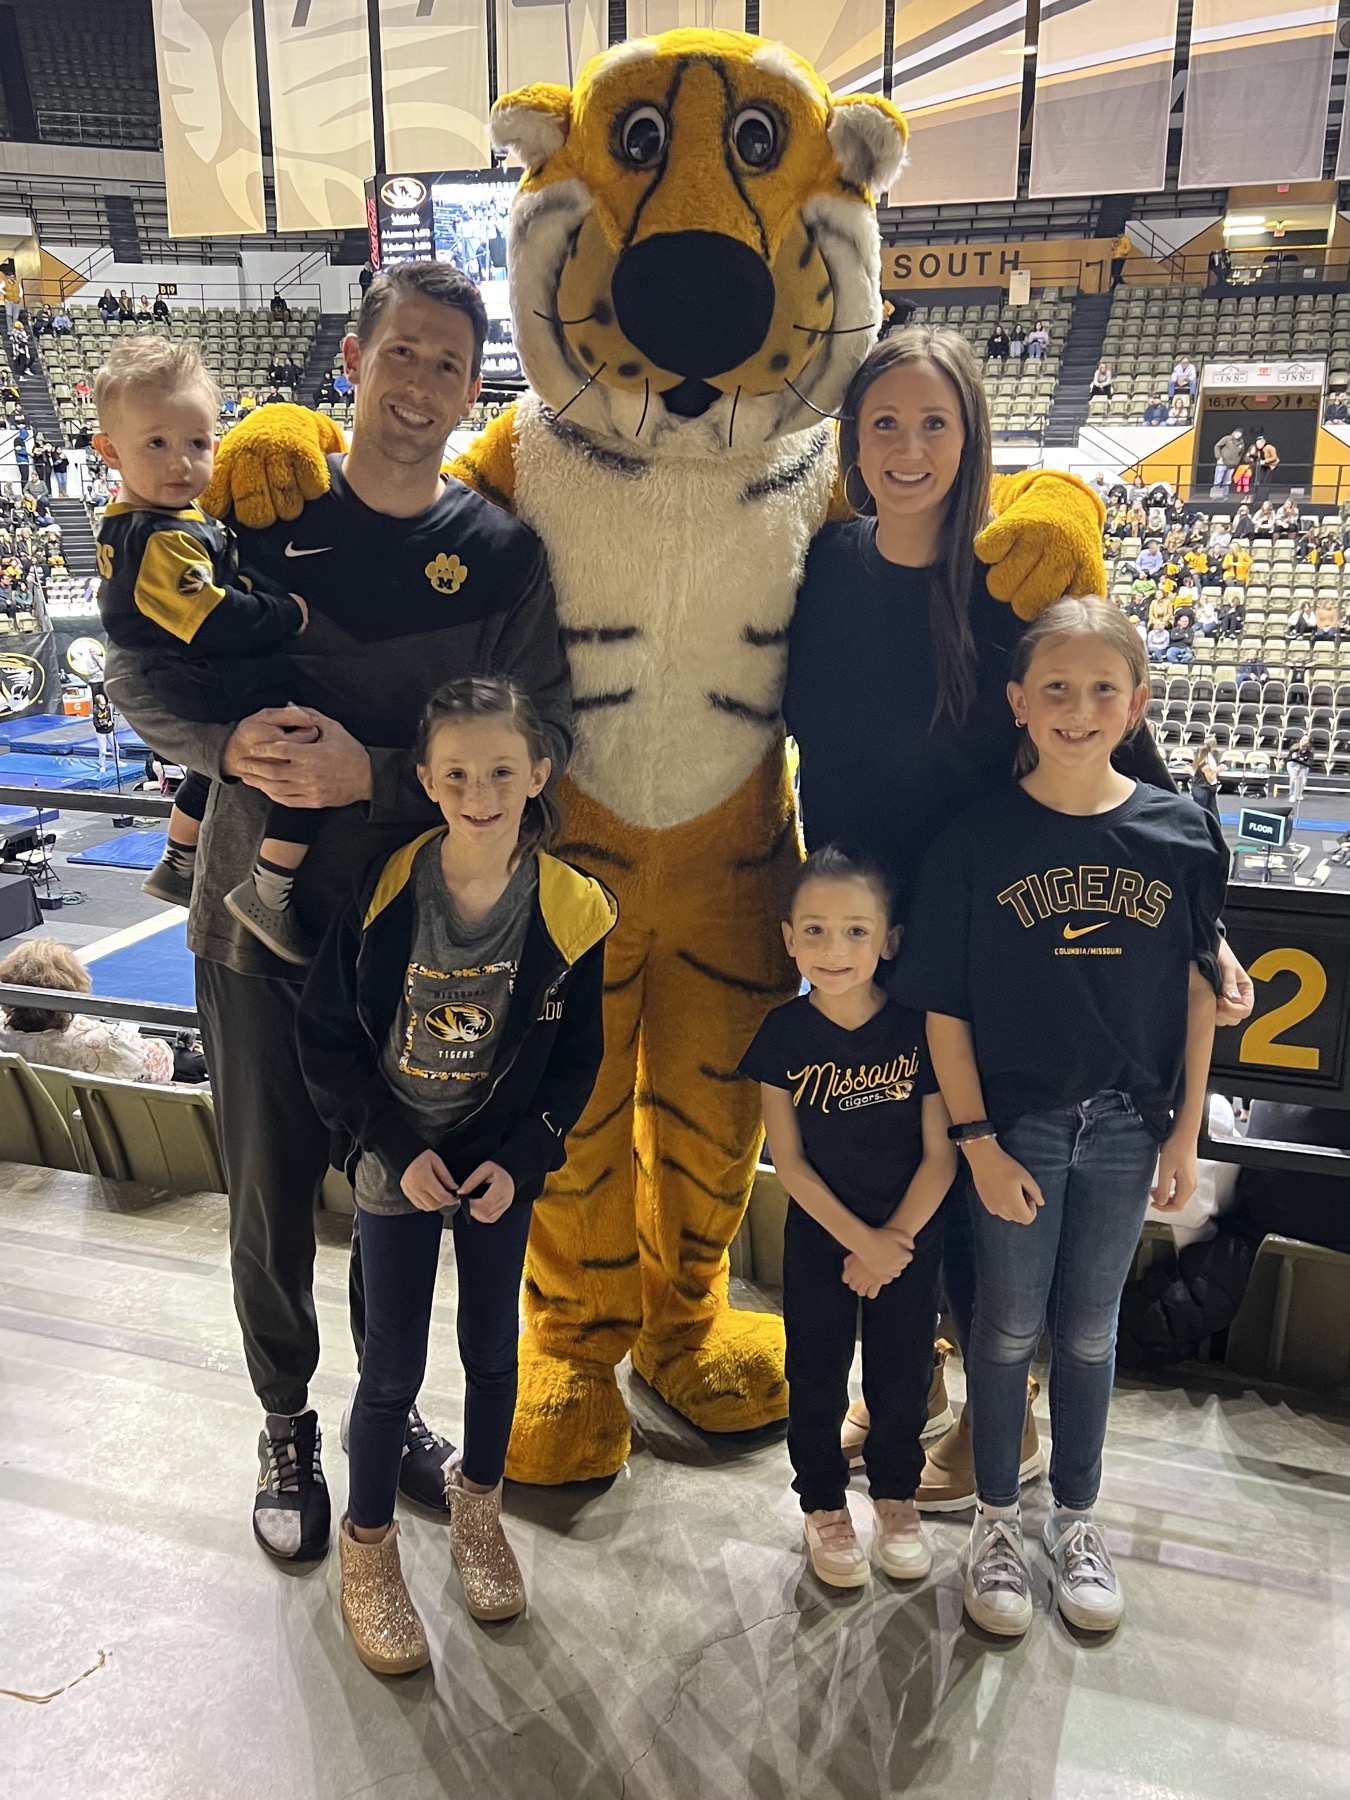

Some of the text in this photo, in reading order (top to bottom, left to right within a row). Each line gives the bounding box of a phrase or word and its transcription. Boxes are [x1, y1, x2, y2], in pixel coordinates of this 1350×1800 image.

[893, 250, 1020, 279] SOUTH
[73, 703, 82, 711] G
[1248, 821, 1274, 835] FLOOR
[997, 866, 1173, 928] TIGERS
[1239, 947, 1327, 1071] 2
[438, 1050, 475, 1059] TIGERS
[786, 1045, 919, 1114] Missouri
[845, 1091, 880, 1108] tigers
